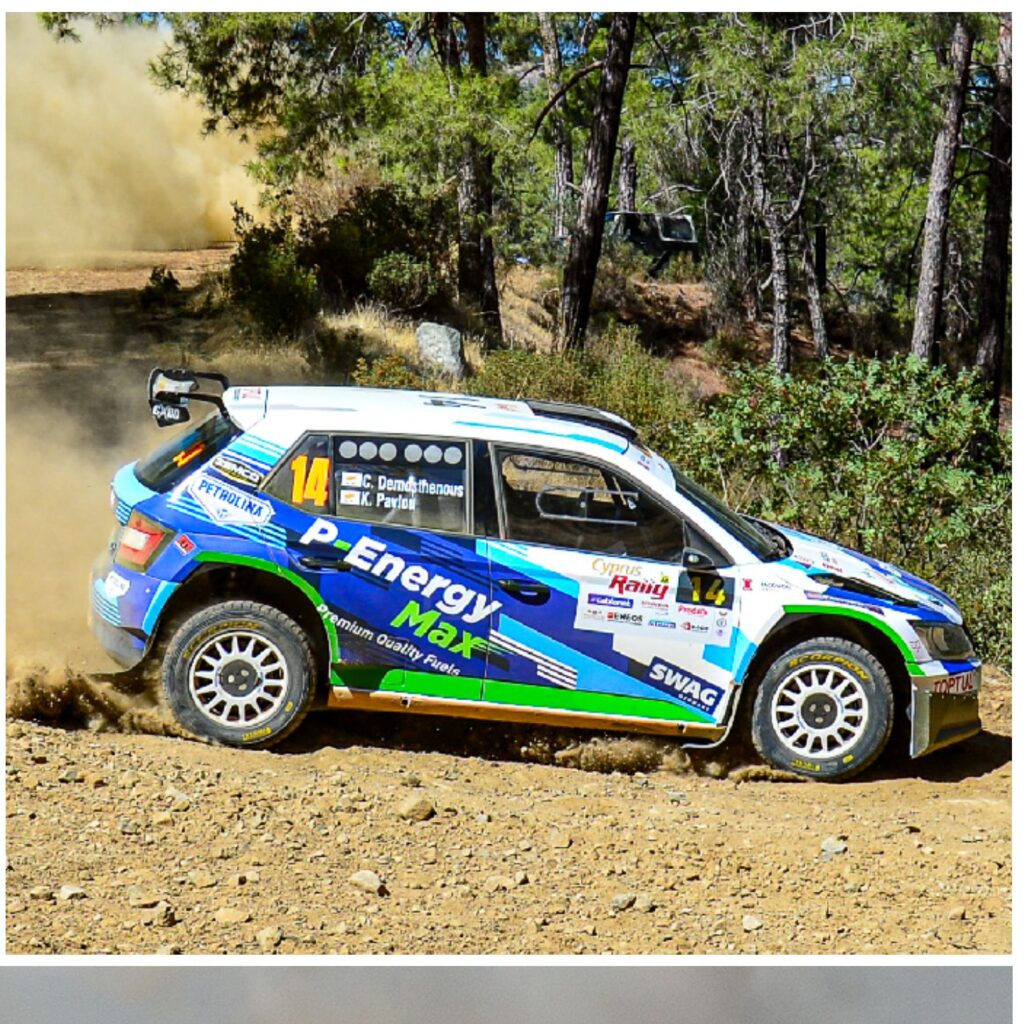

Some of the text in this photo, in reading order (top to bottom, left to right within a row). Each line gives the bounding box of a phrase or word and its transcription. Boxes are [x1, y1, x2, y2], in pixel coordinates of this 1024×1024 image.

[198, 479, 264, 518] PETROLINA
[291, 454, 330, 507] 14
[363, 474, 374, 489] C.
[360, 491, 416, 511] K. Pavlou
[299, 517, 503, 623] P-Energy
[592, 558, 643, 577] Cyprus
[609, 575, 669, 600] Rally
[692, 576, 726, 606] 14
[316, 604, 461, 677] Premium Quality Fuels
[390, 600, 480, 659] Max
[649, 663, 719, 707] SWAG
